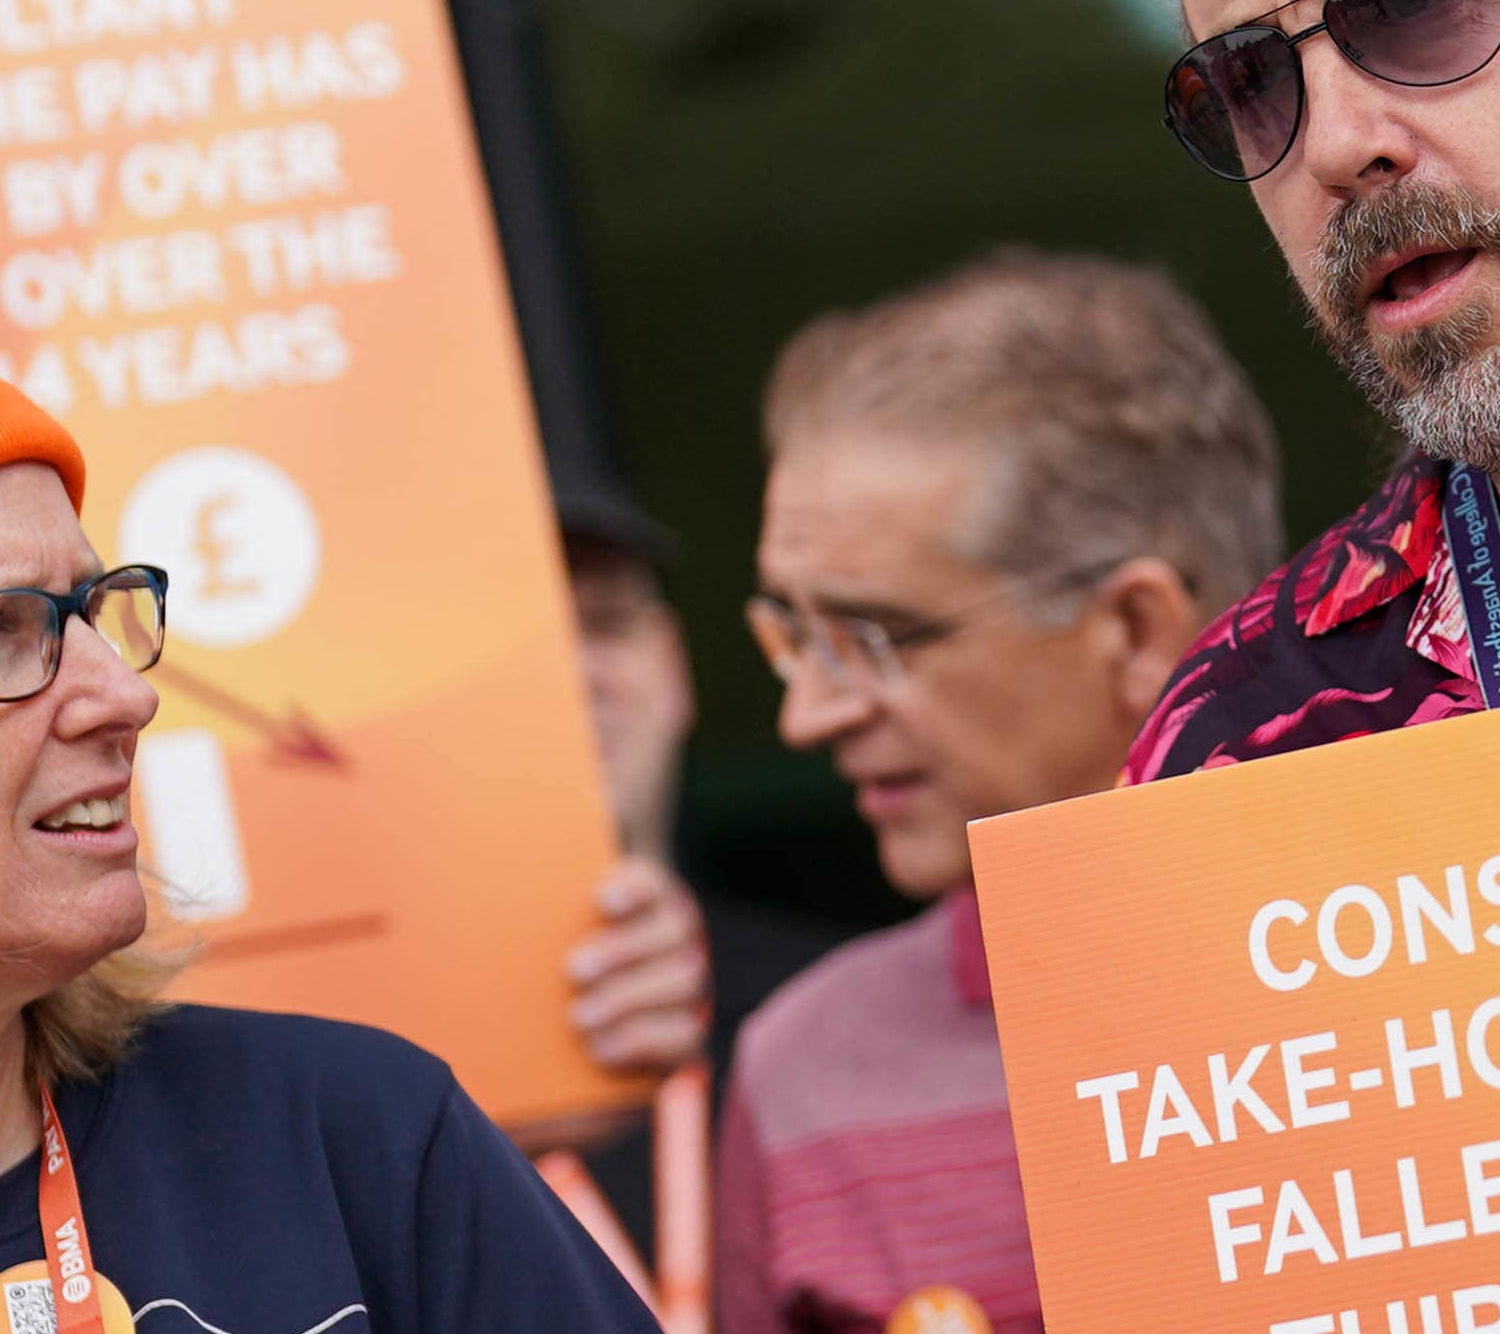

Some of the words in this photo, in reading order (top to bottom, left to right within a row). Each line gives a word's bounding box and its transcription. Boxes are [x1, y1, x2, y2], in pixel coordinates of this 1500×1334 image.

[75, 51, 212, 135] PAY
[233, 24, 402, 102] HAS
[6, 155, 102, 234] BY
[121, 122, 341, 216] OVER
[0, 232, 224, 328] OVER
[231, 206, 399, 290] THE
[80, 305, 347, 409] YEARS
[55, 1217, 85, 1279] BMA
